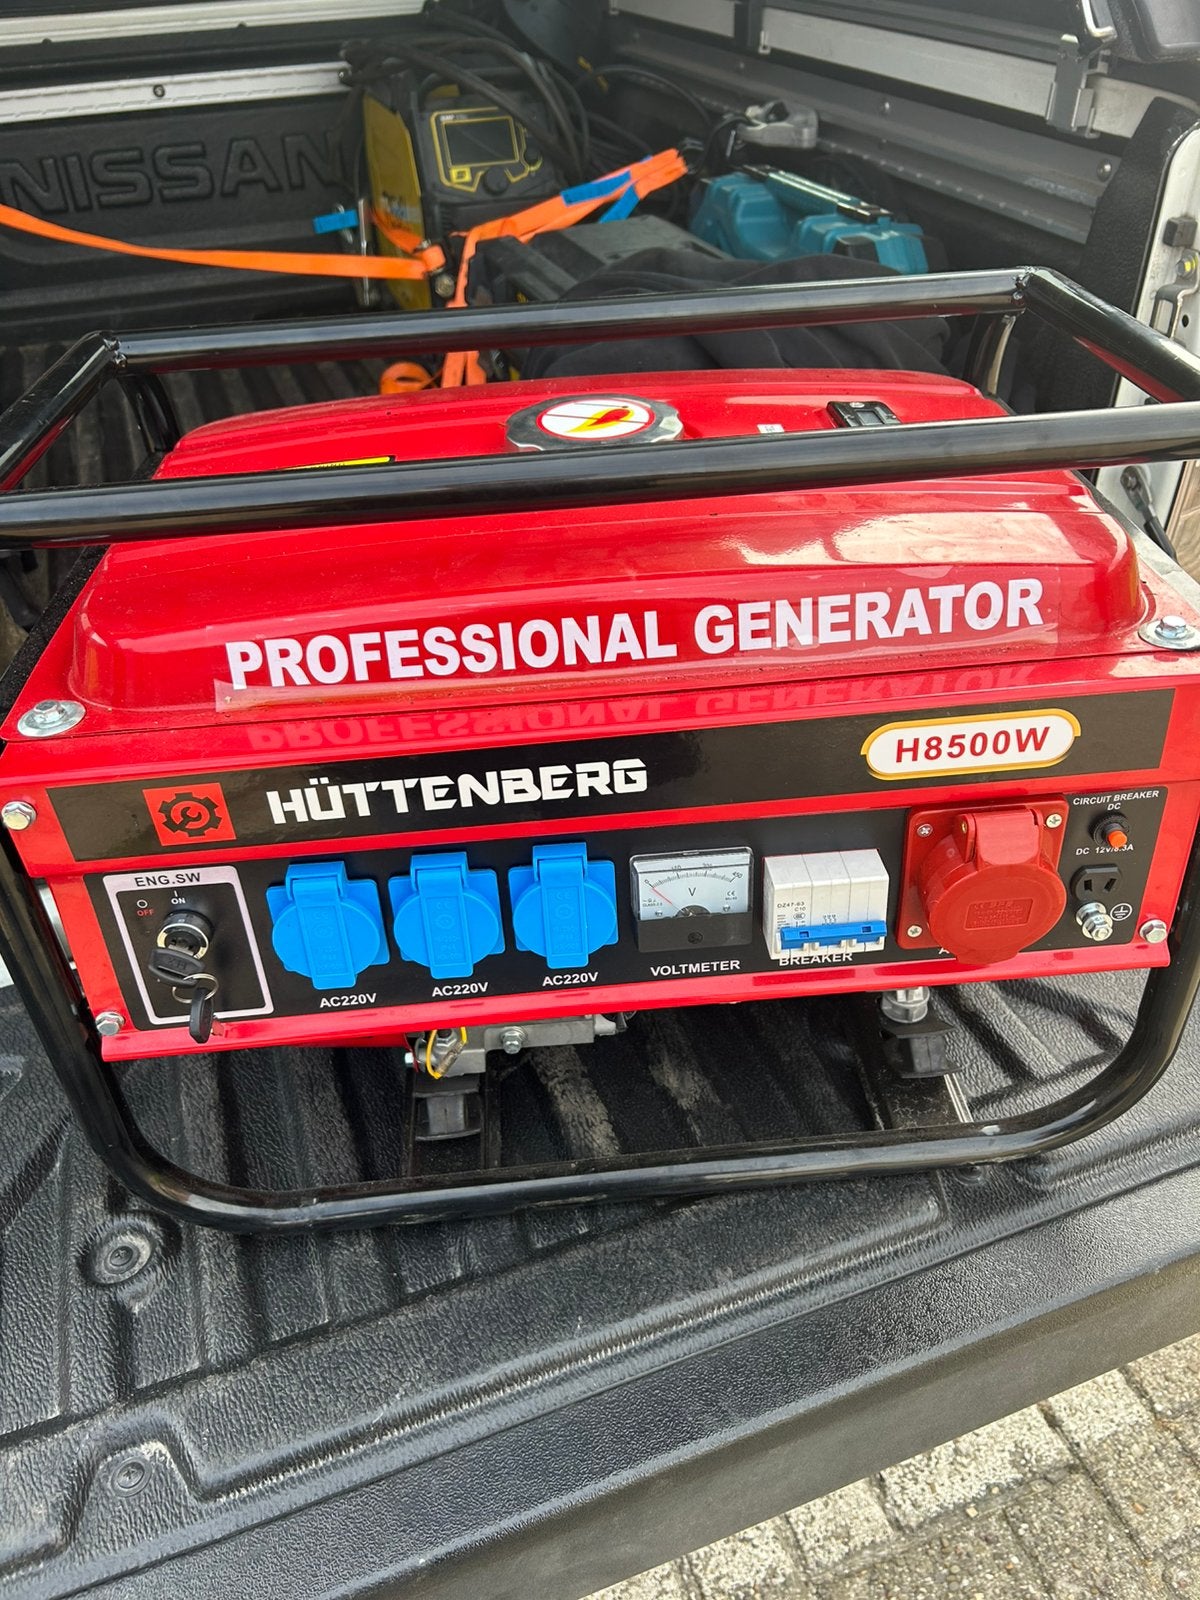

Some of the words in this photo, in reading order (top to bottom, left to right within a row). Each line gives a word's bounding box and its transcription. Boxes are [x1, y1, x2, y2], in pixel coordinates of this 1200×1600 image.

[225, 610, 677, 690] PROFESSIONAL
[694, 577, 1044, 654] GENERATOR
[895, 726, 1050, 763] H8500W
[266, 757, 648, 824] HÜTTENBERG
[1072, 795, 1112, 805] CIRCUIT
[1113, 790, 1160, 802] BREAKER
[1107, 802, 1121, 811] DC
[1075, 847, 1090, 856] DC
[134, 872, 201, 887] ENG.SW
[688, 887, 697, 897] V
[171, 897, 186, 905] ON
[137, 908, 155, 917] OFF
[779, 952, 853, 967] BREAKER
[650, 959, 741, 977] VOLTMETER
[542, 971, 599, 987] AC220V
[432, 981, 489, 997] AC220V
[319, 992, 377, 1008] AC220V
